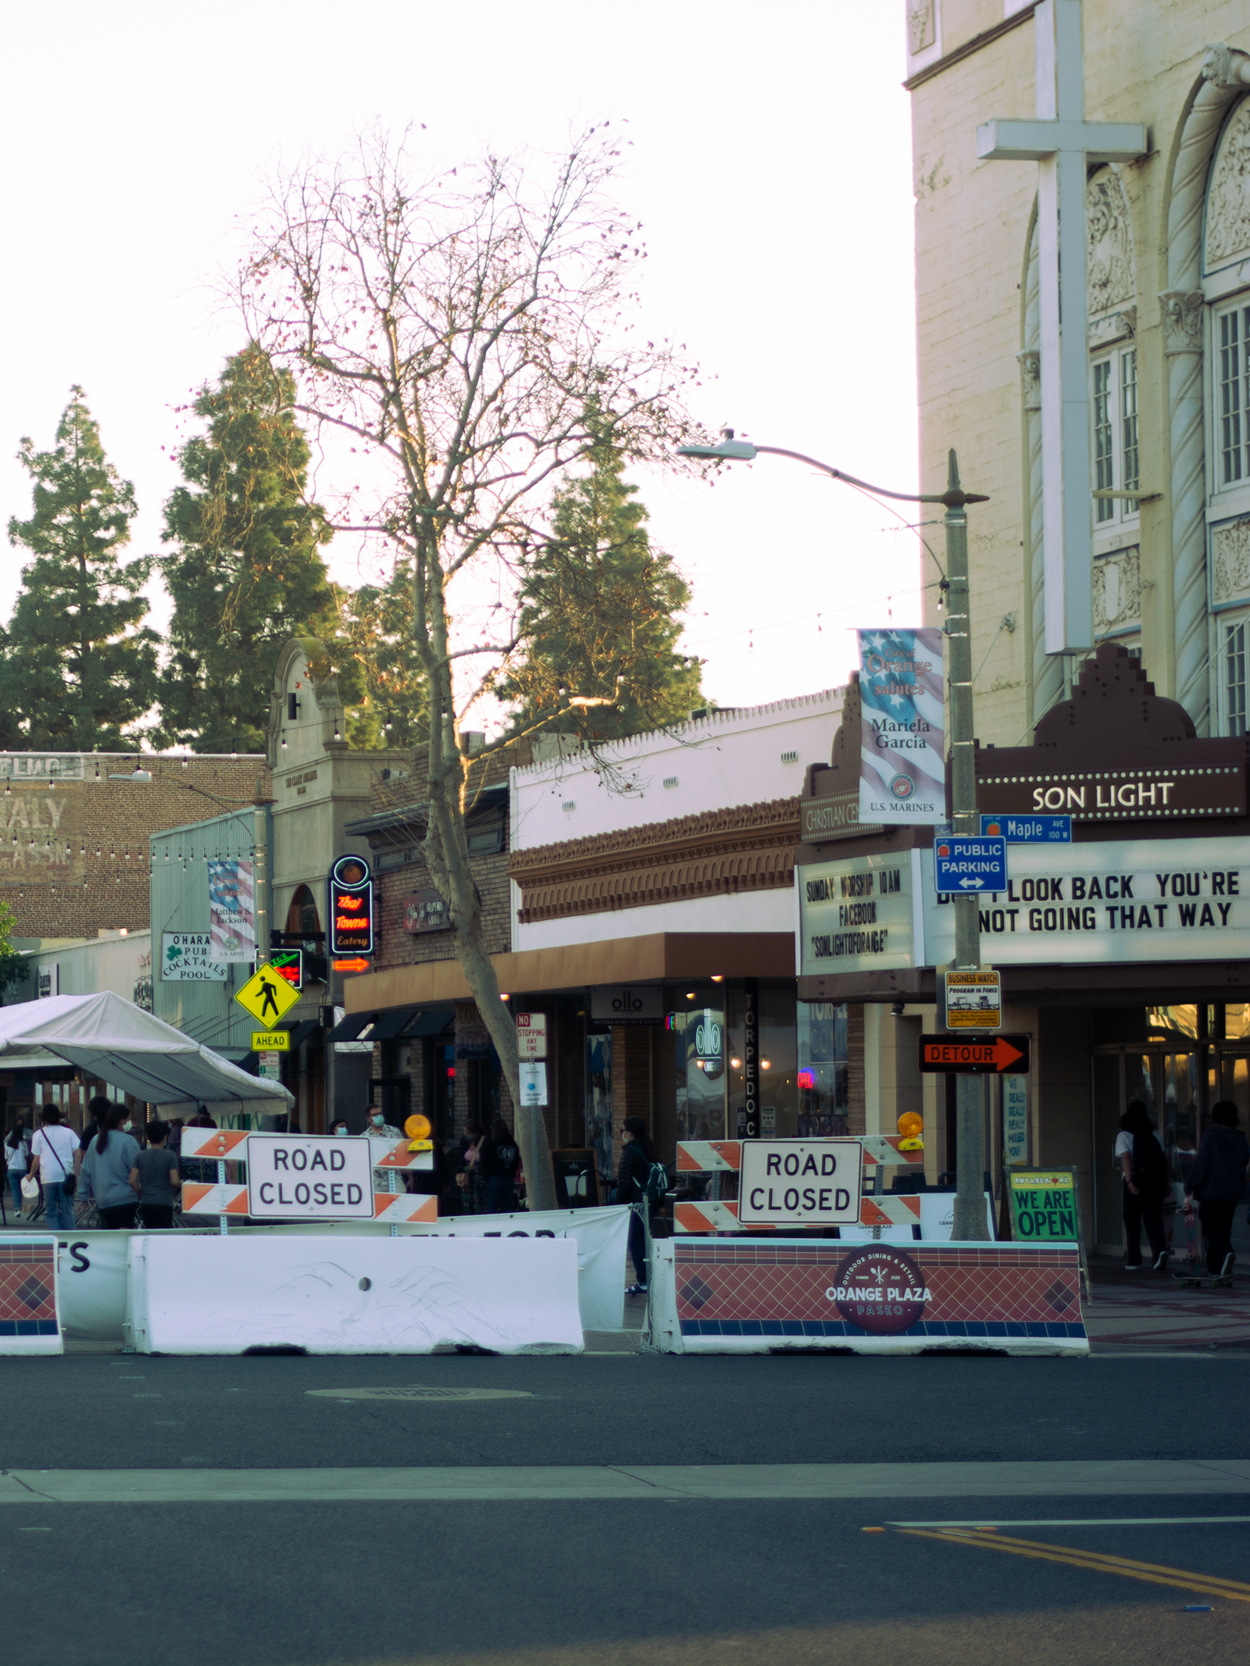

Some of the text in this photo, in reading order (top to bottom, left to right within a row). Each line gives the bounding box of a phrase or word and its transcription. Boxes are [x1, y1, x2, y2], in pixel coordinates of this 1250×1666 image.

[867, 653, 932, 676] Orange
[874, 681, 925, 695] salutes
[871, 718, 931, 732] Mariela
[875, 735, 927, 749] Garcia
[1032, 782, 1174, 811] SON LIGHT
[870, 802, 934, 813] U.S. MARINES
[806, 806, 845, 832] CHRISTIAN
[1052, 820, 1065, 828] AVE
[1007, 820, 1043, 840] Maple
[1048, 831, 1068, 839] 100 W
[954, 844, 1002, 856] PUBLIC
[941, 861, 1000, 873] PARKING
[806, 877, 835, 903] SUNDAY
[840, 872, 874, 899] WORSHIP
[1007, 876, 1064, 903] LOOK
[1071, 874, 1134, 901] BACK
[1155, 870, 1239, 898] YOU'RE
[211, 908, 244, 916] Matthew
[839, 901, 877, 927] FACEBOOK
[979, 902, 1232, 933] NOT GOING THAT WAY
[216, 916, 248, 924] Jackson
[336, 916, 368, 929] Towne
[337, 936, 368, 947] Eatery
[184, 947, 207, 955] PUB
[163, 956, 227, 978] COCKTAILS
[180, 970, 211, 979] POOL
[948, 974, 997, 984] BUSINESS WATCH
[612, 990, 643, 1010] ollo
[518, 1016, 529, 1026] NO
[517, 1029, 545, 1037] STOPPING
[256, 1036, 285, 1046] AHEAD
[930, 1046, 994, 1062] DETOUR
[1009, 1078, 1017, 1090] WE
[1008, 1092, 1025, 1104] REALLY
[1008, 1105, 1025, 1117] REALLY
[1008, 1119, 1025, 1131] REALLY
[1008, 1131, 1025, 1144] MISSED
[1008, 1146, 1021, 1157] YOU!
[273, 1149, 346, 1171] ROAD
[766, 1153, 837, 1176] ROAD
[259, 1182, 363, 1206] CLOSED
[749, 1187, 850, 1211] CLOSED
[1014, 1190, 1072, 1209] WE ARE
[1017, 1210, 1075, 1236] OPEN
[842, 1256, 866, 1286] OUTDOOR
[868, 1253, 892, 1261] DINING
[900, 1263, 916, 1286] RETAIL
[825, 1286, 933, 1302] ORANGE PLAZA
[856, 1304, 903, 1316] PASEO
